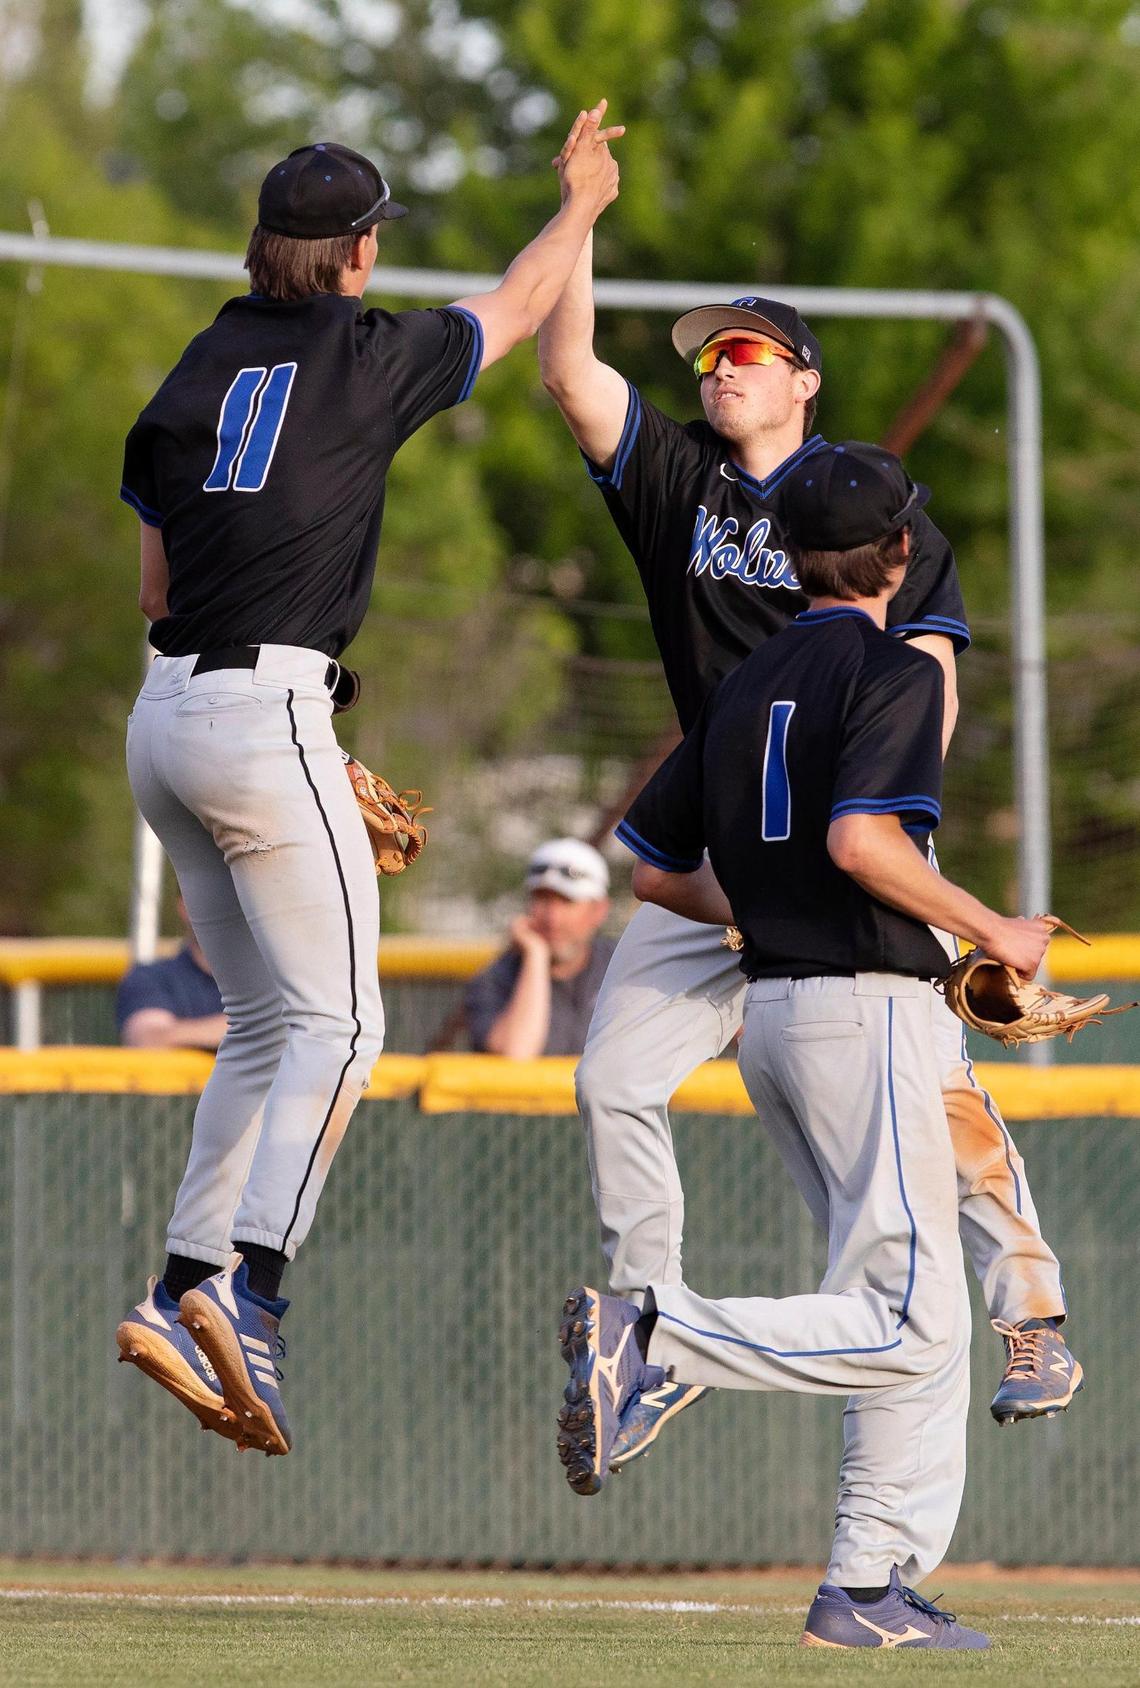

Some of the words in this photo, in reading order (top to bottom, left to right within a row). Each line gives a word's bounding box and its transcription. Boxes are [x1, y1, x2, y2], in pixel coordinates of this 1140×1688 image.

[202, 361, 298, 492] 11
[686, 504, 802, 590] Wolve
[762, 701, 796, 842] 1
